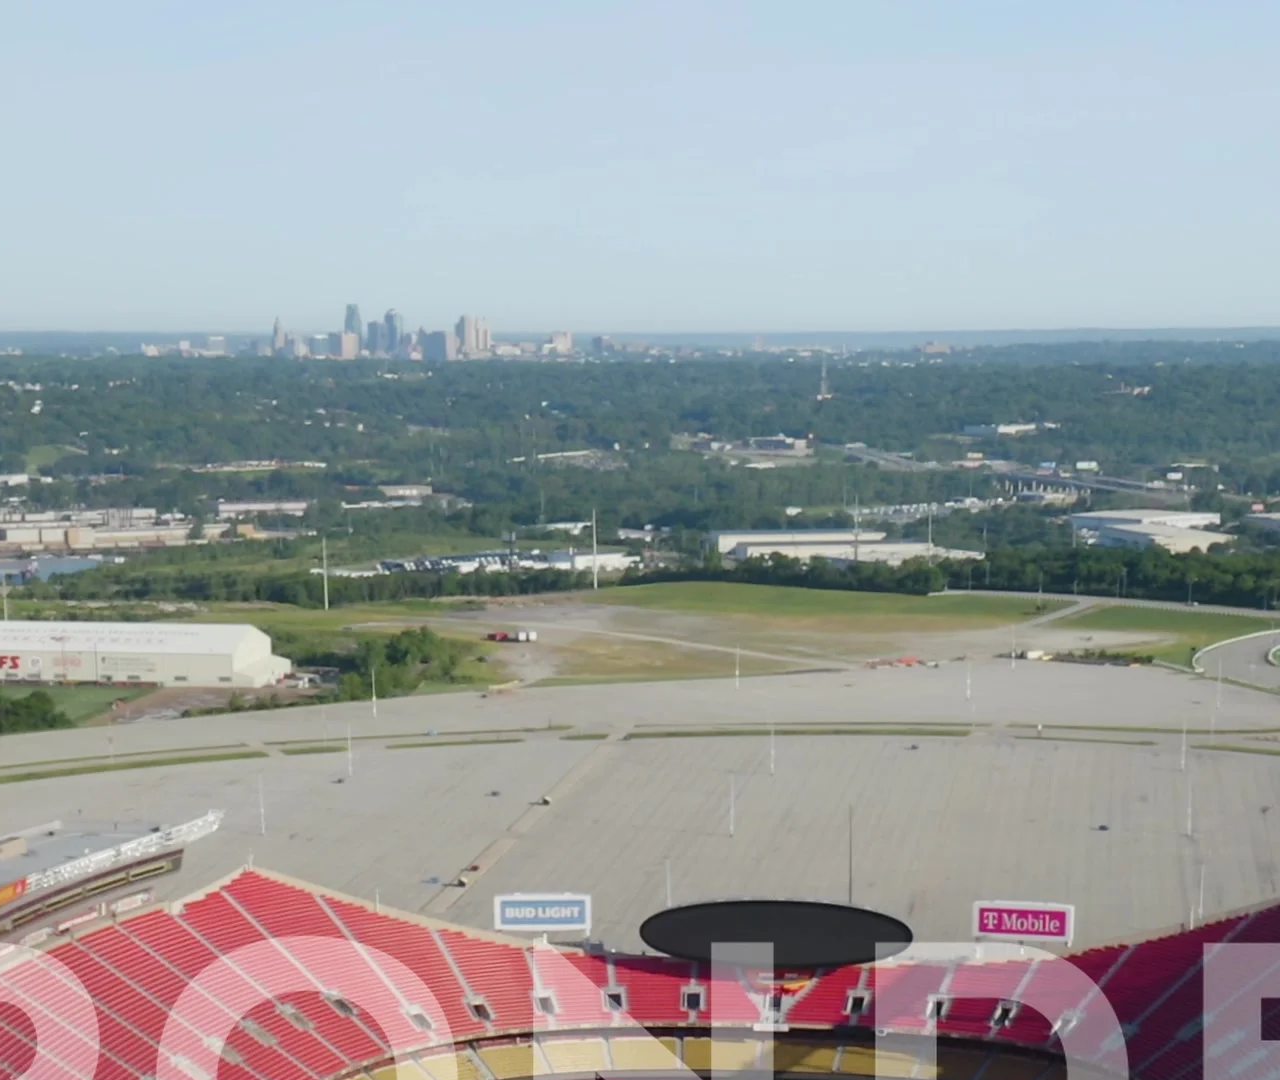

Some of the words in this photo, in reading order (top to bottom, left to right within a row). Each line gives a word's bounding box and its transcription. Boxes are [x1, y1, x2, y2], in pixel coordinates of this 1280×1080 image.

[504, 907, 536, 918] BUD
[538, 906, 580, 919] LIGHT
[1001, 912, 1061, 933] Mobile
